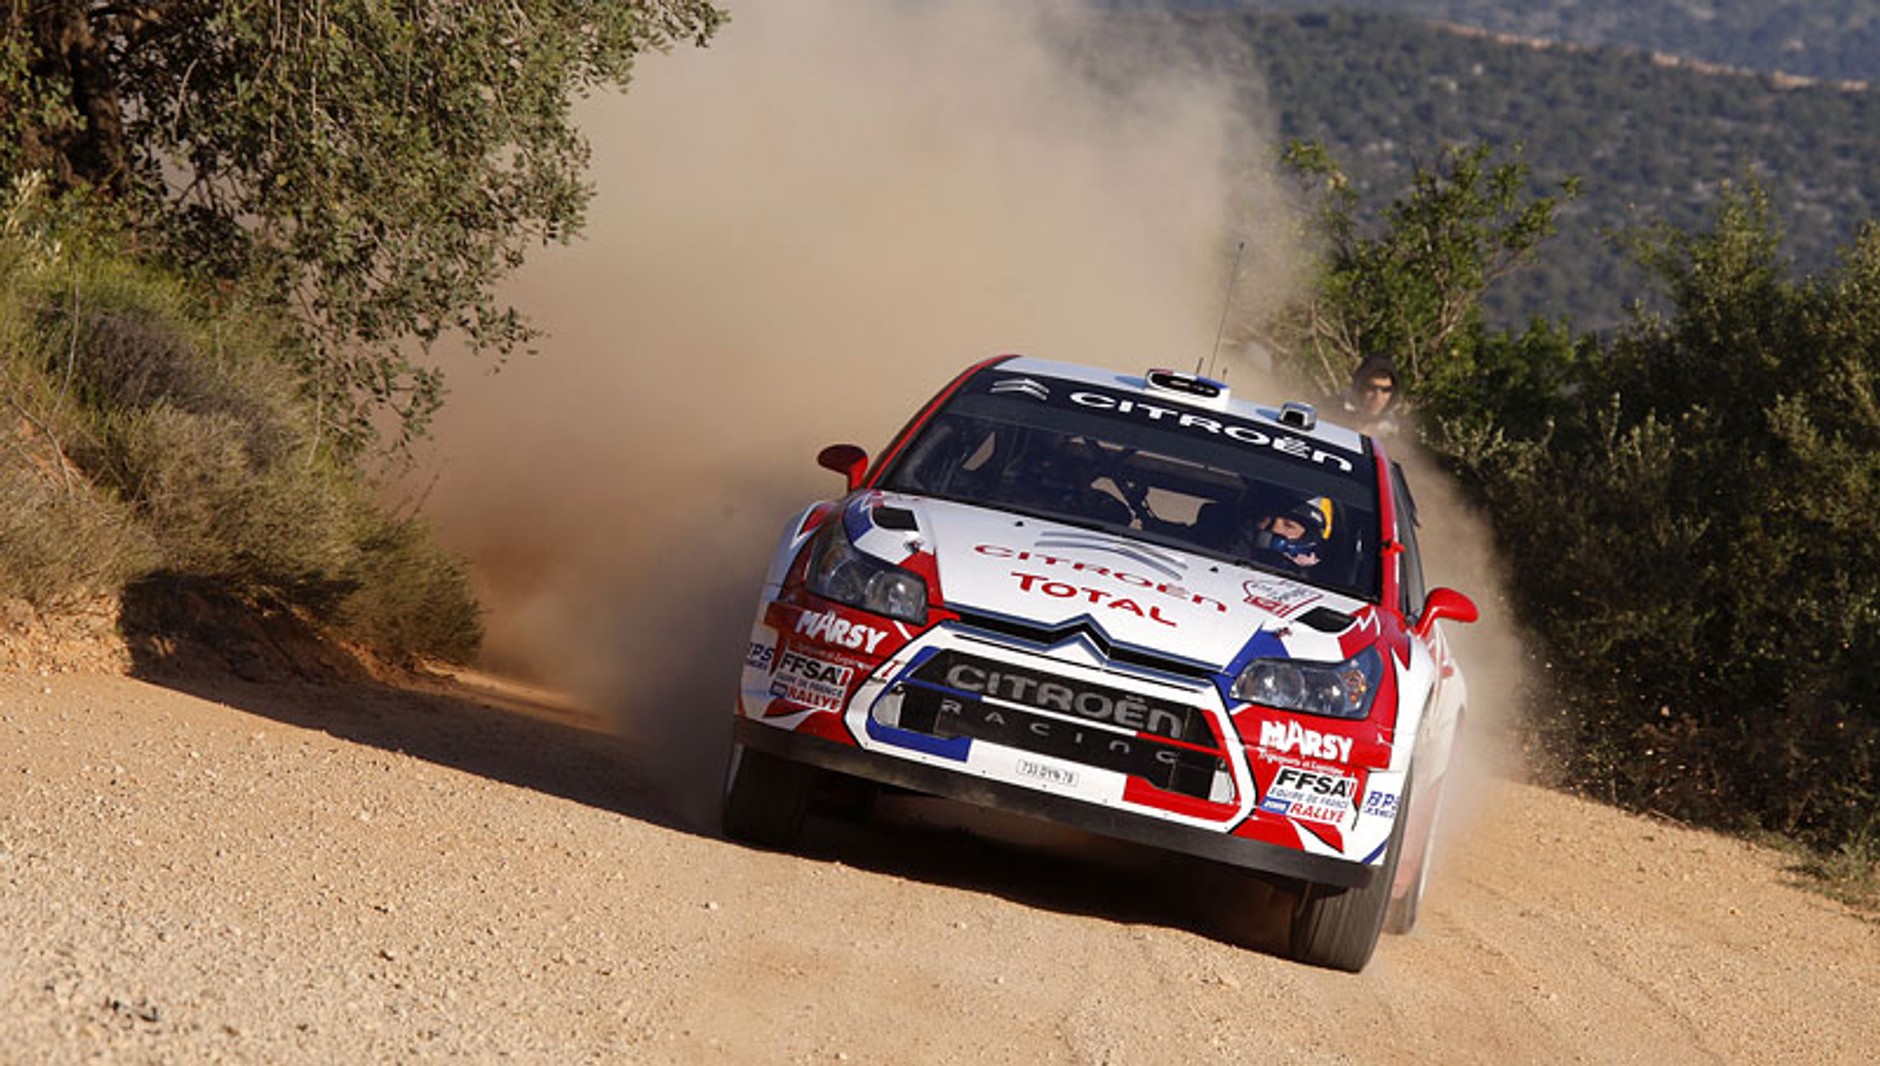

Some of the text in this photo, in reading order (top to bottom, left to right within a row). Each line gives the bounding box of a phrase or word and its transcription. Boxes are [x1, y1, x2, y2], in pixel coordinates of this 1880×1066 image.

[1011, 571, 1178, 628] TOTAL
[795, 609, 889, 654] MARSY
[787, 686, 842, 711] RALLYE
[1260, 720, 1354, 764] MARSY
[1289, 803, 1346, 824] RALLYE
